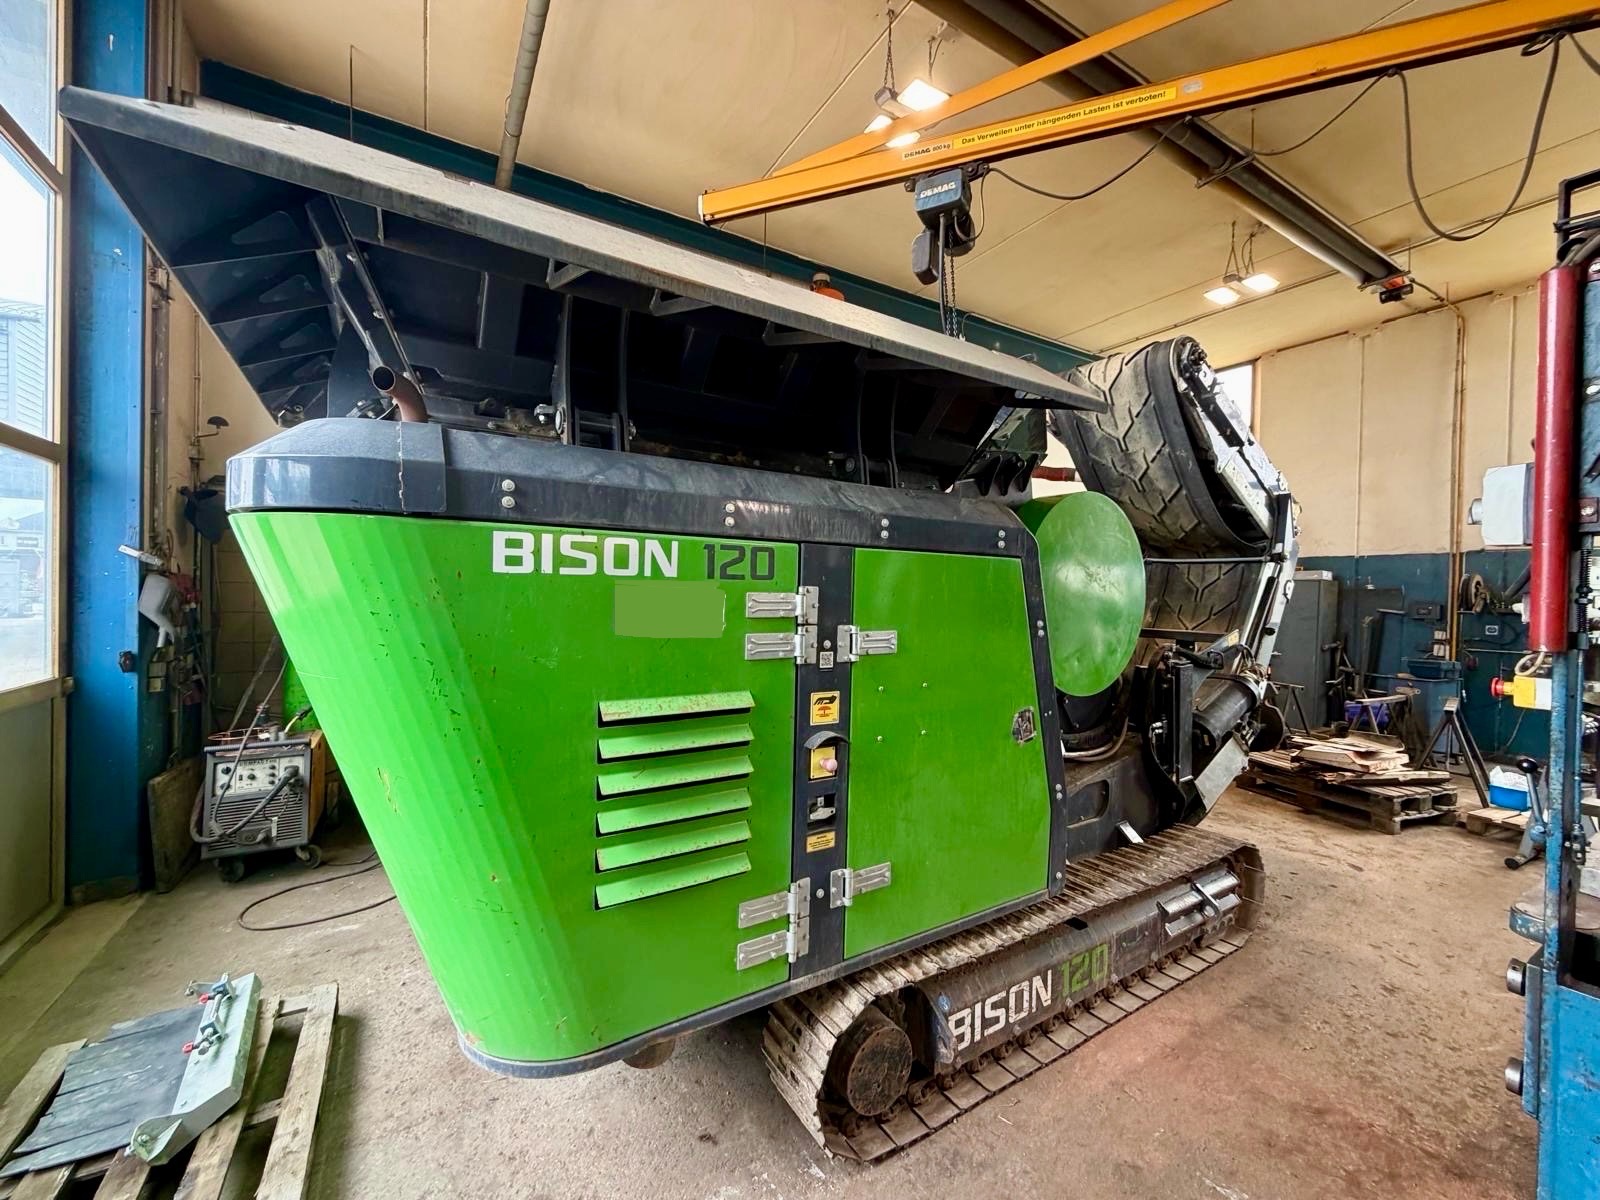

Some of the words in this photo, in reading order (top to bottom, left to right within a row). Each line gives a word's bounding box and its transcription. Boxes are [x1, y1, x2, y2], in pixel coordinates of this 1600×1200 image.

[961, 137, 976, 145] Das
[977, 128, 1013, 141] Verweilen
[1014, 123, 1035, 135] unter
[1036, 111, 1082, 127] hängenden
[1083, 103, 1111, 116] Lasten
[1112, 100, 1124, 109] ist
[1125, 90, 1167, 106] verboten!
[904, 147, 931, 159] DEMAG
[919, 181, 956, 199] DEMAG
[492, 530, 679, 578] BISON
[703, 543, 775, 581] 120
[948, 969, 1052, 1051] BISON
[1060, 943, 1109, 997] 120
